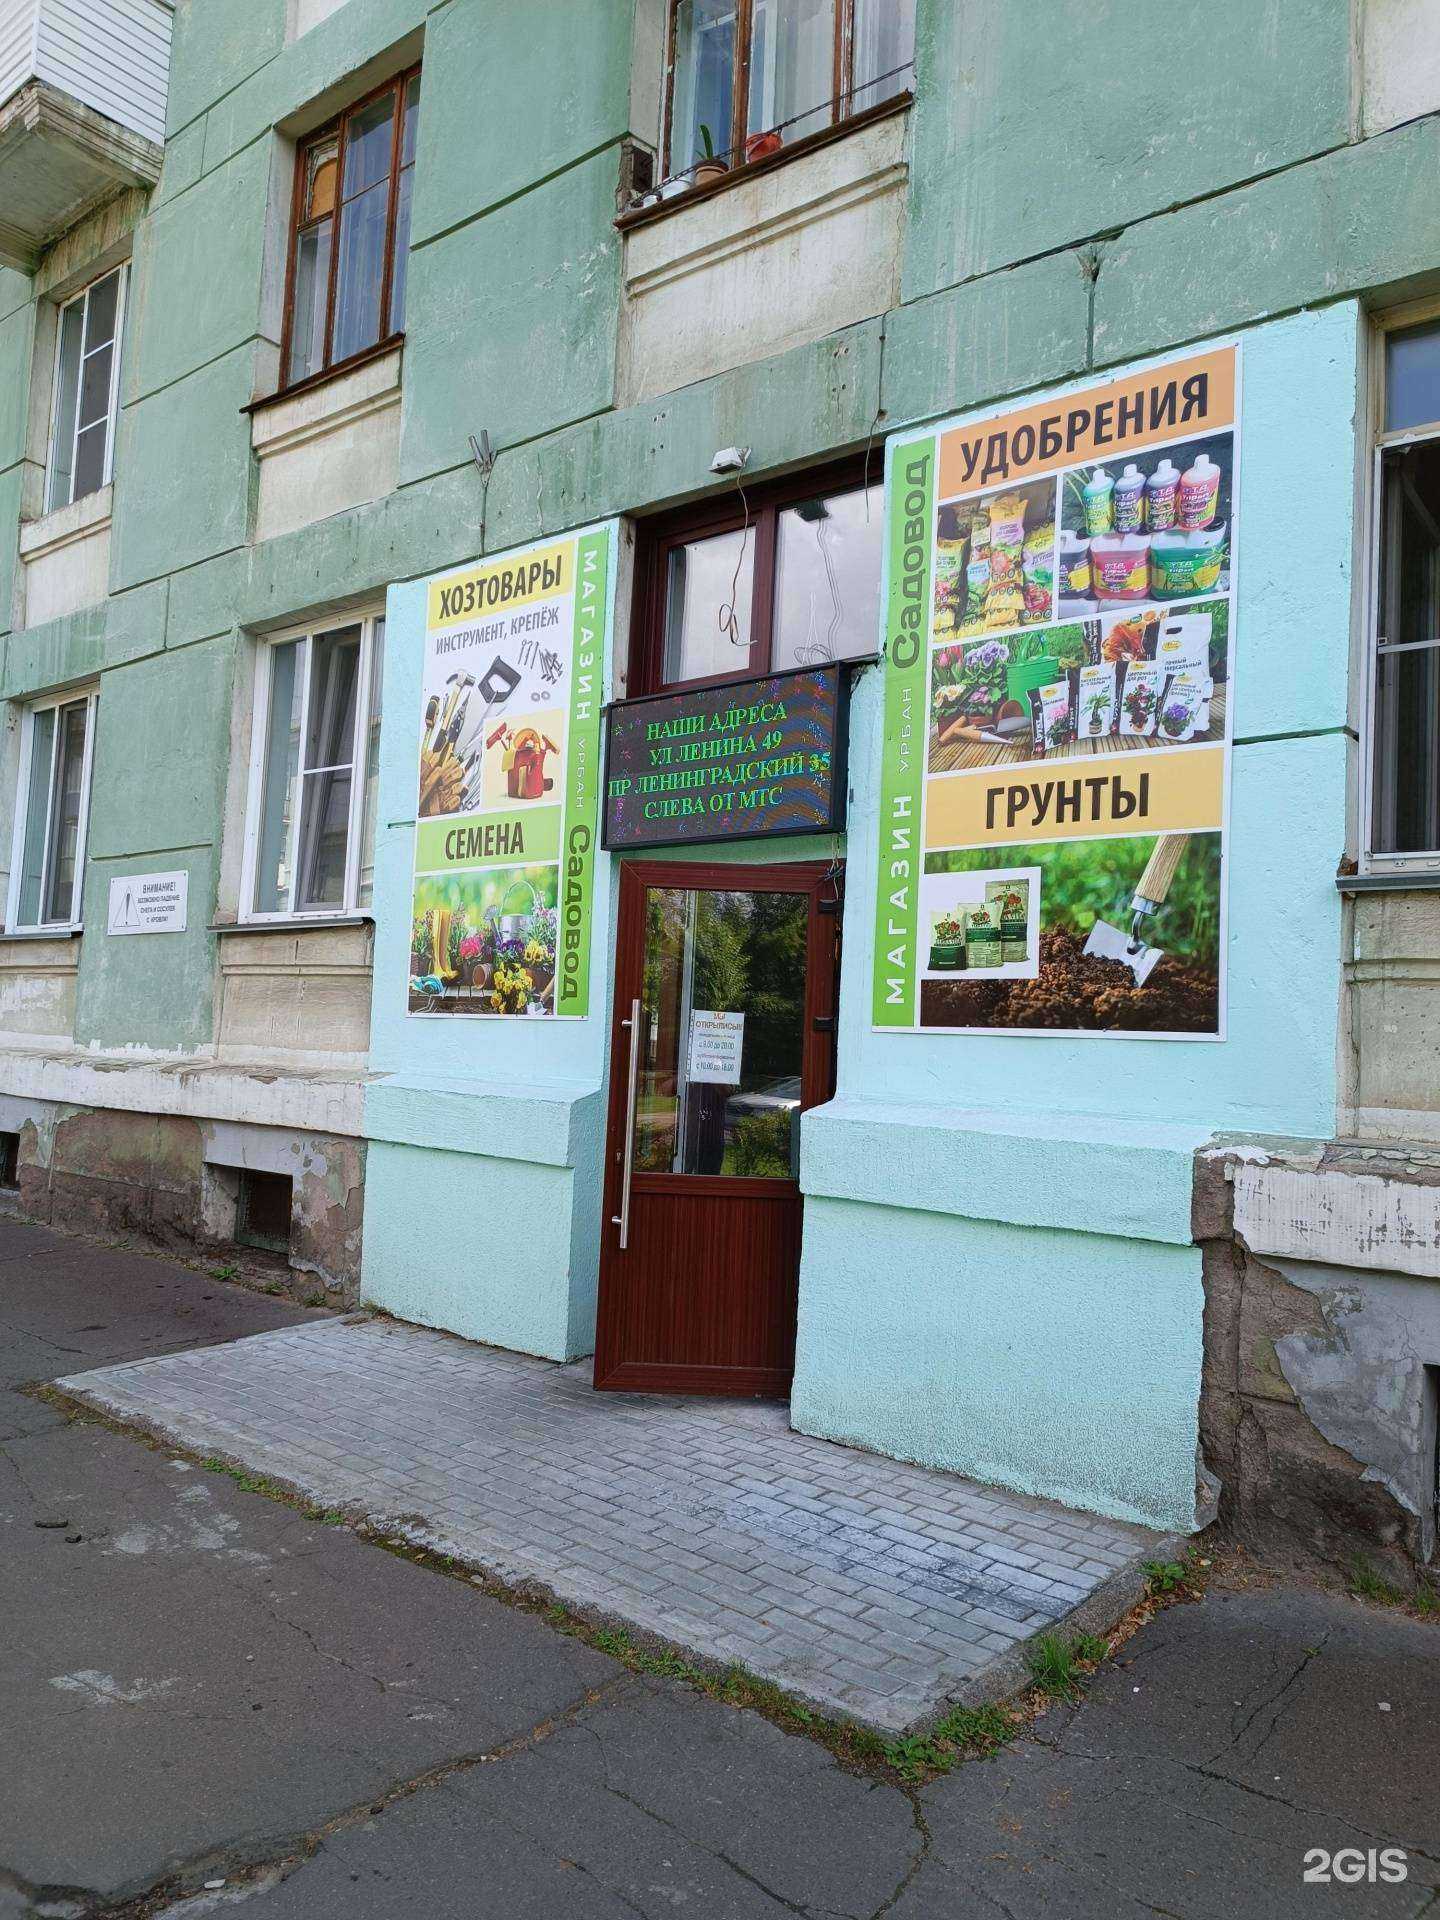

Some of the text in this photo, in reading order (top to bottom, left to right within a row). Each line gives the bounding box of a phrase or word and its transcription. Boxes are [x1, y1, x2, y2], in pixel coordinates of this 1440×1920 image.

[960, 372, 1209, 484] УДОБРЕНИЯ
[438, 555, 562, 619] ХОЗТОВАРЫ
[436, 606, 560, 655] ИНСТРУМЕНТ, КРЕПЁЖ
[646, 701, 787, 741] НАШИ АДРЕСА
[885, 454, 931, 1004] МАГАЗИН УРБАН Садовод
[675, 736, 757, 764] ЛЕНИНА
[762, 730, 783, 750] 49
[561, 549, 598, 1001] МАГАЗИН УРБАН Садовод
[608, 777, 631, 798] ПР
[635, 752, 804, 794] ЛЕНИНГРАДСКИЙ
[644, 786, 784, 820] СЛЕВА ОТ МТС
[985, 772, 1150, 830] ГРУНТЫ
[445, 822, 524, 860] СЕМЕНА
